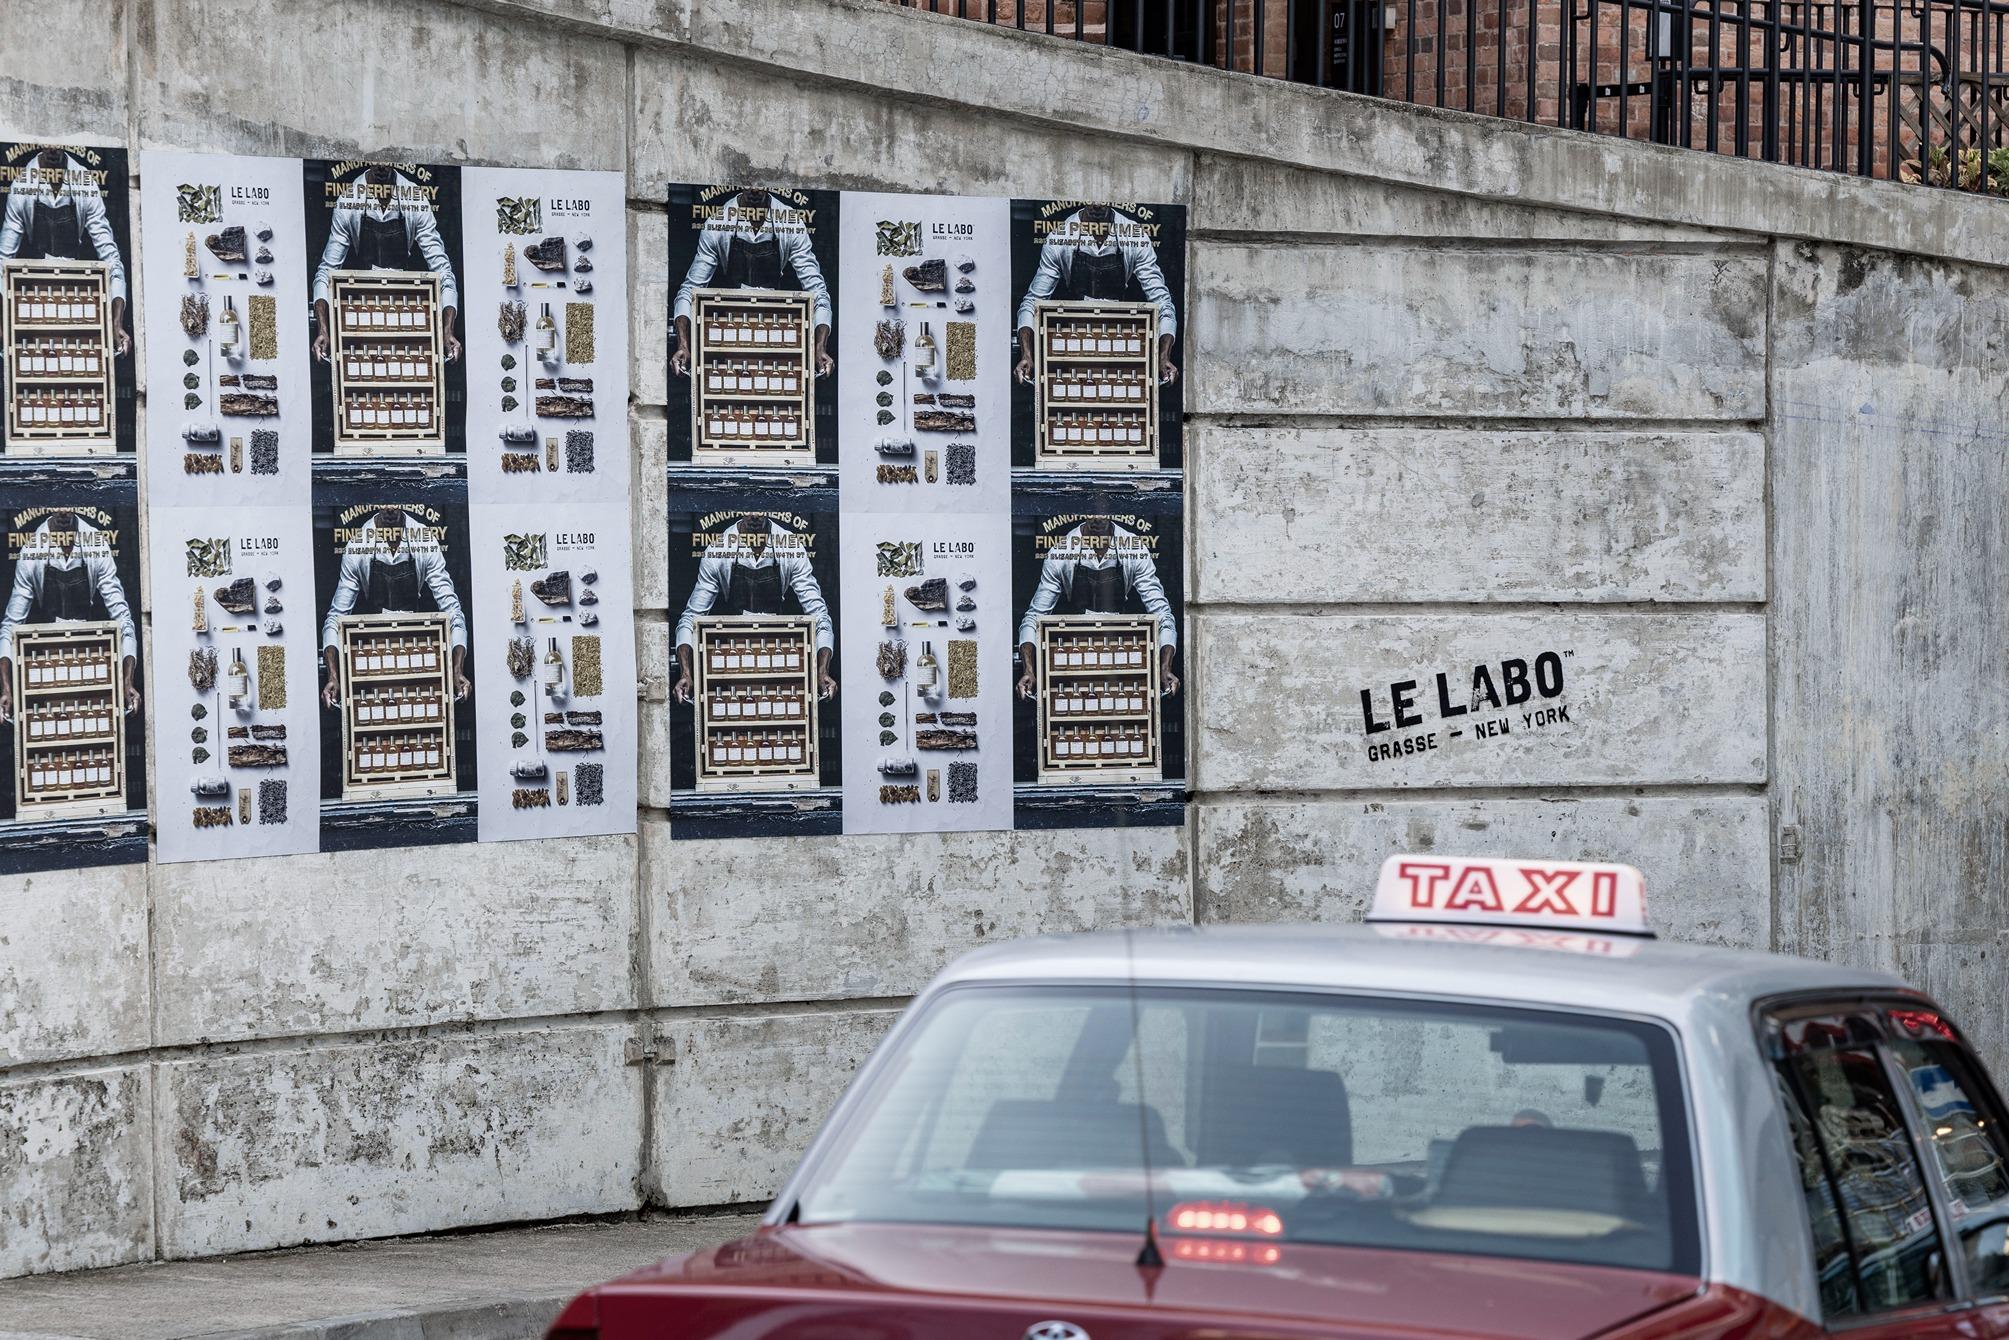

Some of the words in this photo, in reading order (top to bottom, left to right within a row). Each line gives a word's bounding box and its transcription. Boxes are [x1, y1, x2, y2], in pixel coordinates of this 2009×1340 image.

[1334, 12, 1345, 29] 07
[5, 143, 86, 163] MANUERS
[86, 150, 101, 166] OF
[30, 167, 108, 186] PERFUMERY
[331, 160, 416, 179] MANUERS
[417, 167, 432, 182] OF
[231, 186, 243, 198] LE
[245, 187, 270, 199] LABO
[325, 182, 354, 199] FINE
[357, 183, 439, 202] PERFUMERY
[700, 185, 793, 202] MANUERS
[793, 192, 809, 206] OF
[551, 199, 563, 210] LE
[565, 199, 590, 211] LABO
[692, 205, 724, 221] FINE
[728, 206, 817, 224] PERFUMERY
[1041, 199, 1137, 218] MANUERS
[1137, 207, 1154, 221] OF
[932, 223, 945, 234] LE
[947, 223, 973, 235] LABO
[1033, 220, 1066, 236] FINE
[1069, 221, 1161, 238] PERFUMERY
[14, 506, 97, 529] MANUERS
[97, 511, 112, 527] OF
[340, 504, 425, 525] MANUERS
[425, 508, 441, 523] OF
[699, 511, 793, 530] MANUERS
[792, 516, 809, 531] OF
[1042, 514, 1136, 533] MANUERS
[1135, 518, 1153, 533] OF
[8, 532, 37, 549] FINE
[40, 530, 119, 549] PERFUMERY
[240, 538, 253, 550] LE
[254, 537, 279, 549] LABO
[334, 528, 363, 544] FINE
[366, 526, 448, 544] PERFUMERY
[556, 533, 568, 545] LE
[570, 532, 595, 544] LABO
[692, 533, 724, 548] FINE
[727, 533, 817, 549] PERFUMERY
[1035, 535, 1067, 550] FINE
[1071, 535, 1160, 550] PERFUMERY
[933, 542, 946, 553] LE
[948, 542, 974, 553] LABO
[1360, 679, 1423, 735] LE
[1367, 732, 1438, 763] GRASSE
[1475, 717, 1510, 740] NEW
[1522, 704, 1571, 730] YORK
[1398, 862, 1618, 919] TAXI
